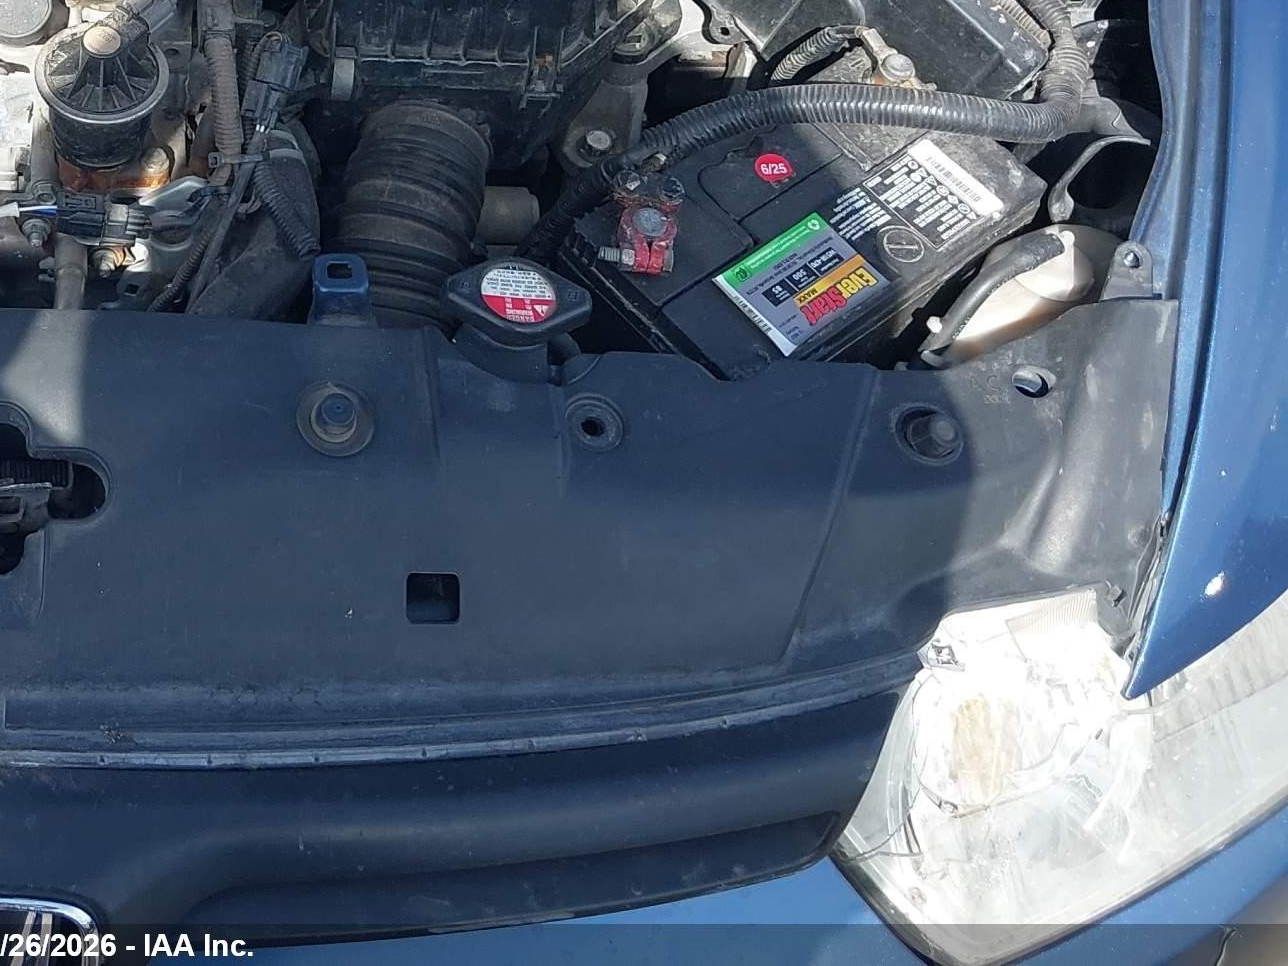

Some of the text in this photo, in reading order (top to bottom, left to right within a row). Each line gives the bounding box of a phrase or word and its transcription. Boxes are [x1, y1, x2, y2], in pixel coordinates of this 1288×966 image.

[760, 163, 788, 175] 6/25
[791, 268, 807, 280] 500
[771, 284, 783, 294] 85
[797, 287, 817, 304] MAXX
[800, 267, 877, 325] EverStart
